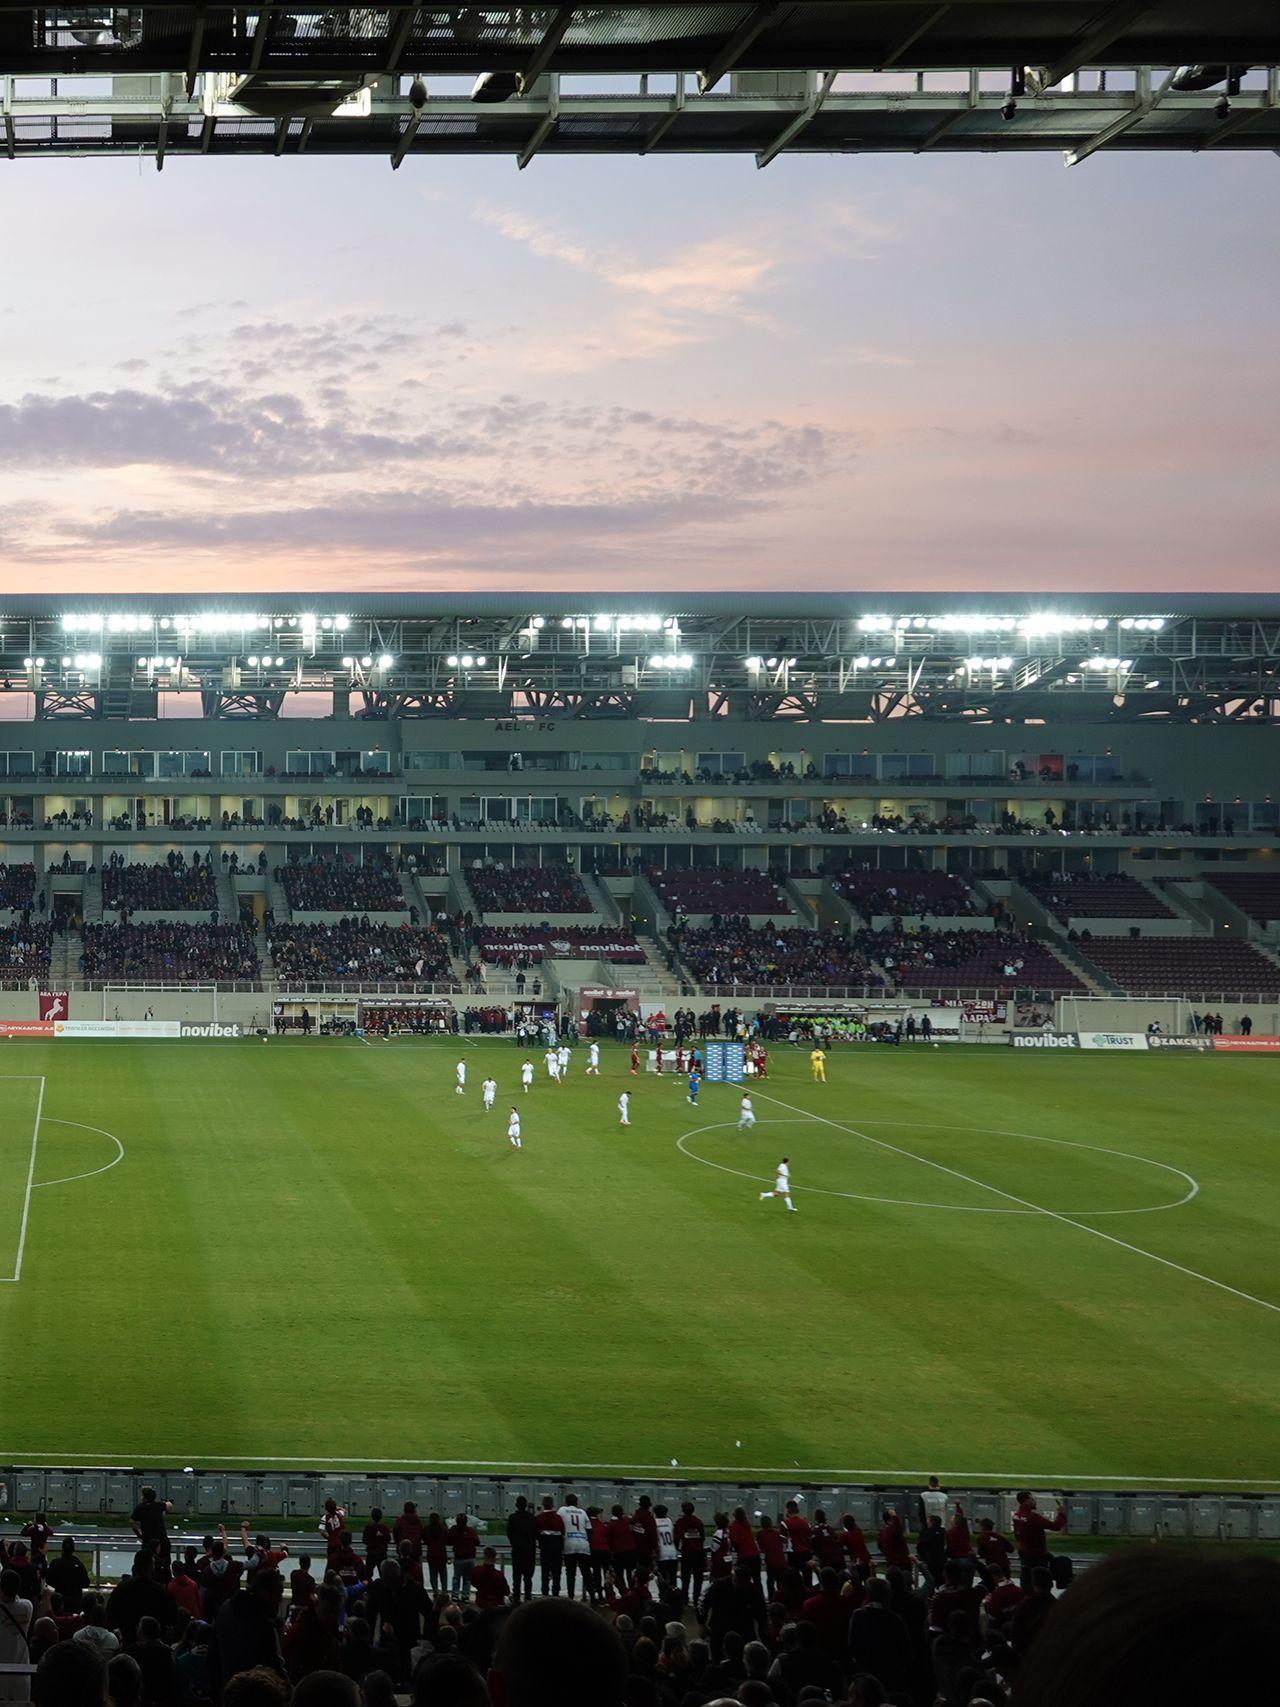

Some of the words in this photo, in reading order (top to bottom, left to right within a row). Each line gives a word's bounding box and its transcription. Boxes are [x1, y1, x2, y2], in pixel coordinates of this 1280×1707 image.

[495, 722, 521, 732] AEL
[538, 722, 556, 732] FC
[484, 942, 547, 952] novibet
[579, 943, 643, 953] novibet
[181, 1023, 240, 1037] novibet
[1013, 1033, 1075, 1047] novibet
[571, 1515, 579, 1531] 4
[660, 1531, 672, 1546] 10
